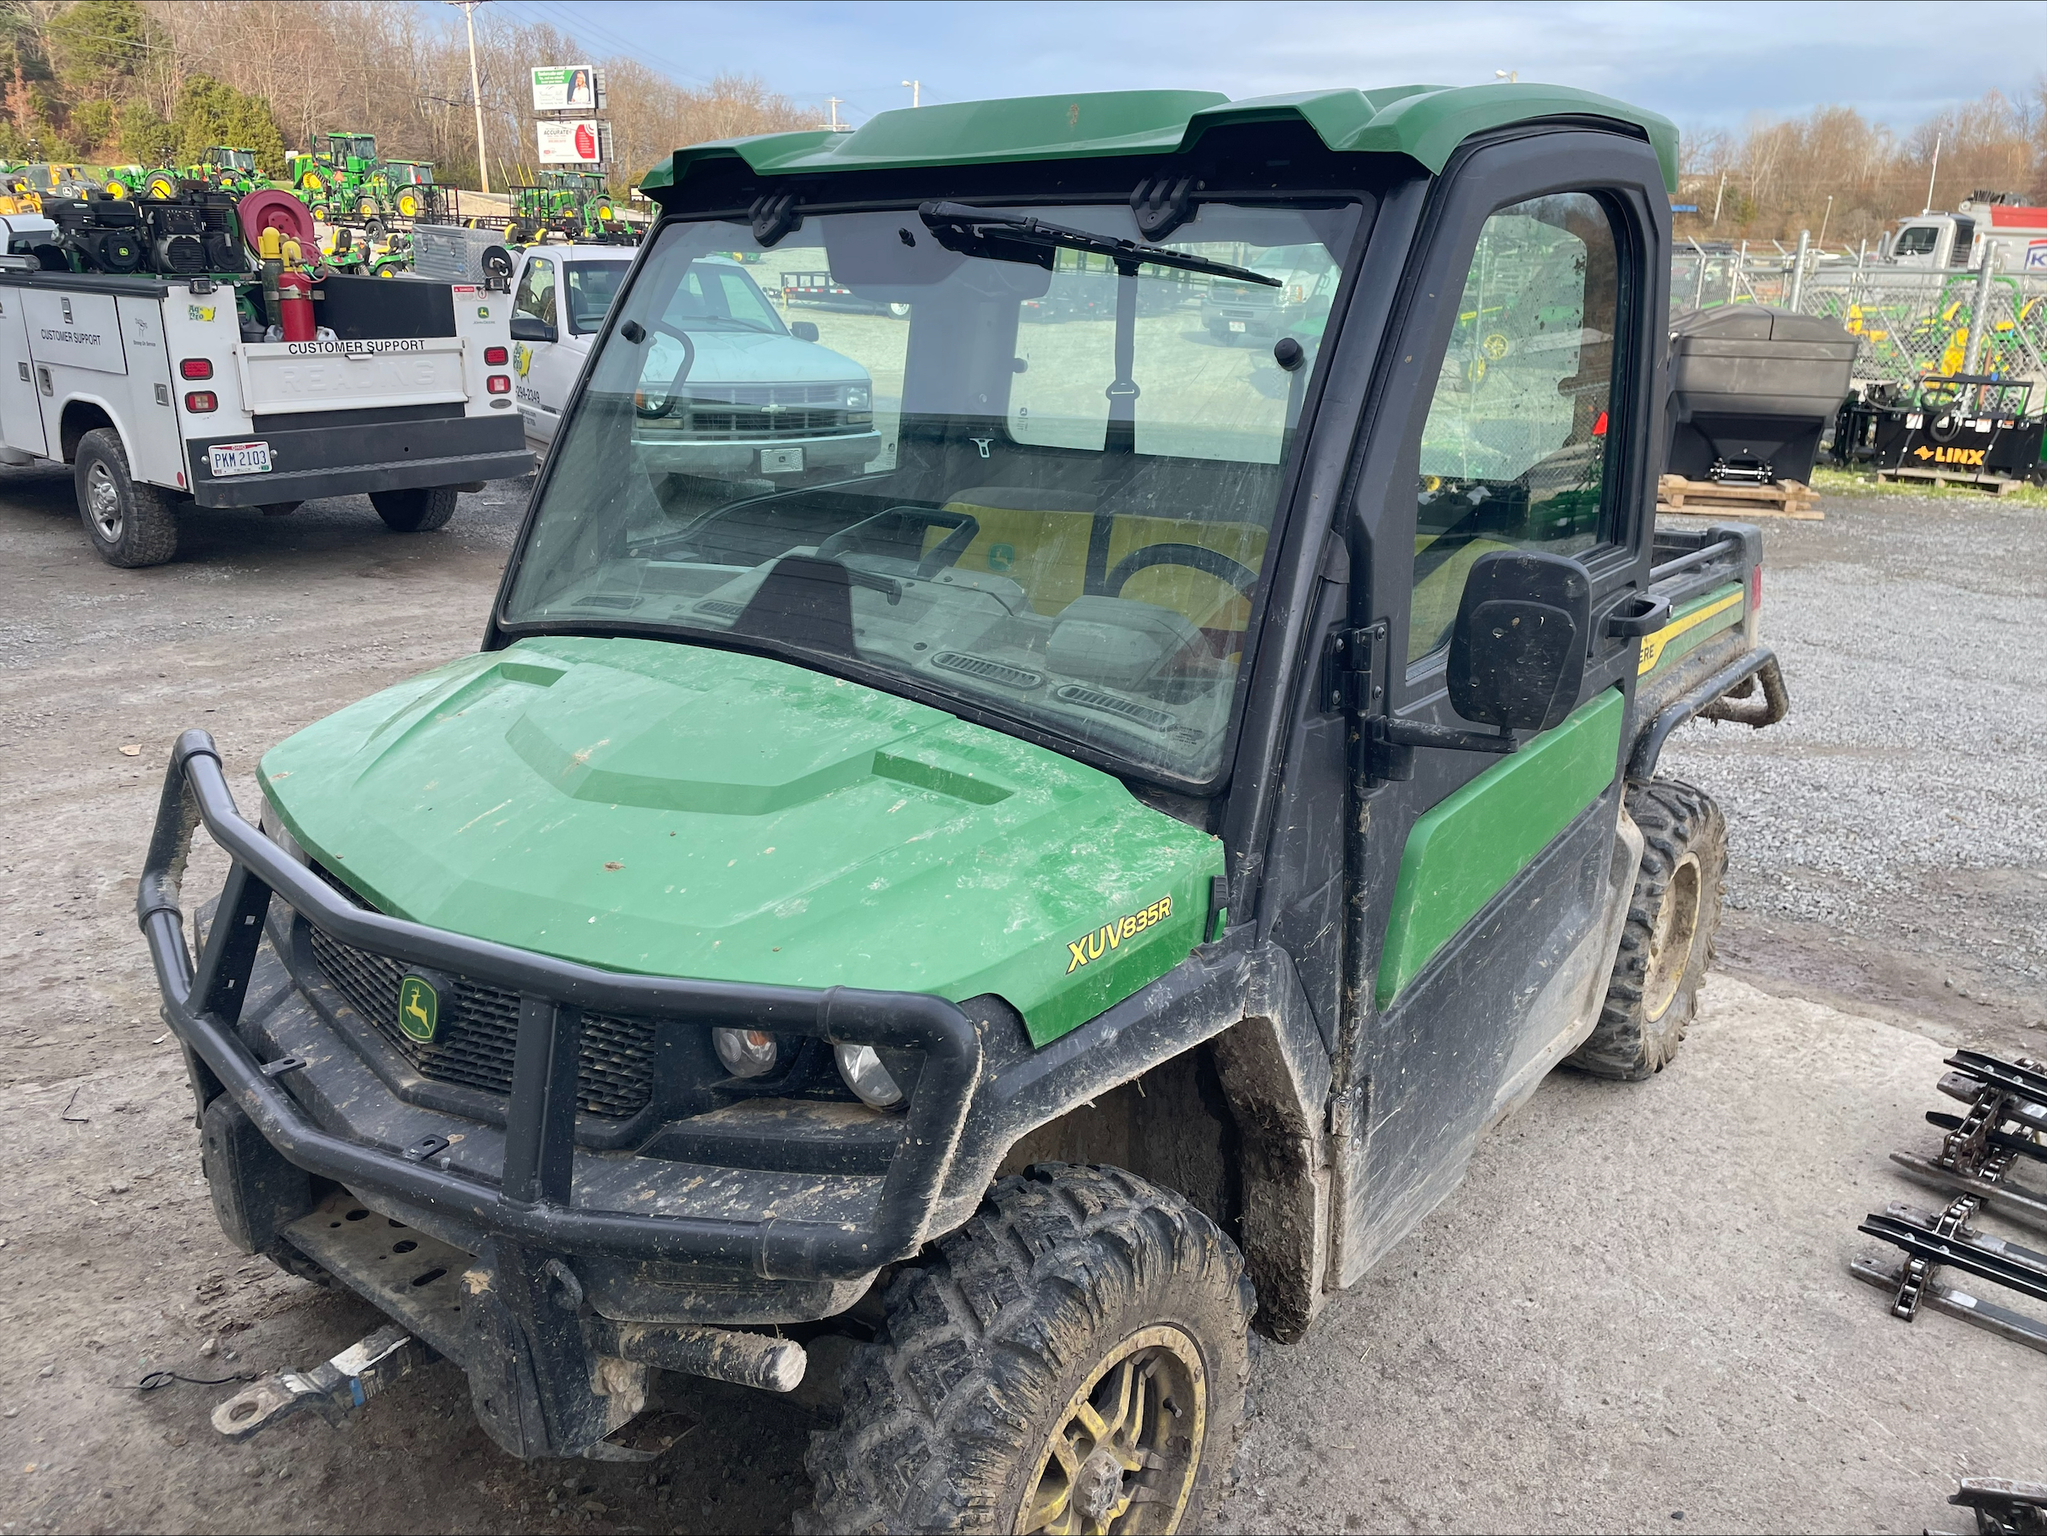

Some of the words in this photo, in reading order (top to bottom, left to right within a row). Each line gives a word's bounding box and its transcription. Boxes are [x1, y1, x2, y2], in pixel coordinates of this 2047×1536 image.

[40, 328, 74, 343] CUSTOMER
[73, 332, 102, 346] SUPPORT
[288, 341, 363, 355] CUSTOMER
[366, 339, 426, 352] SUPPORT
[278, 359, 437, 393] READING
[214, 452, 237, 468] PKM
[239, 450, 267, 466] 2103
[1935, 446, 1985, 466] LINX
[1065, 896, 1172, 976] XUV835R
